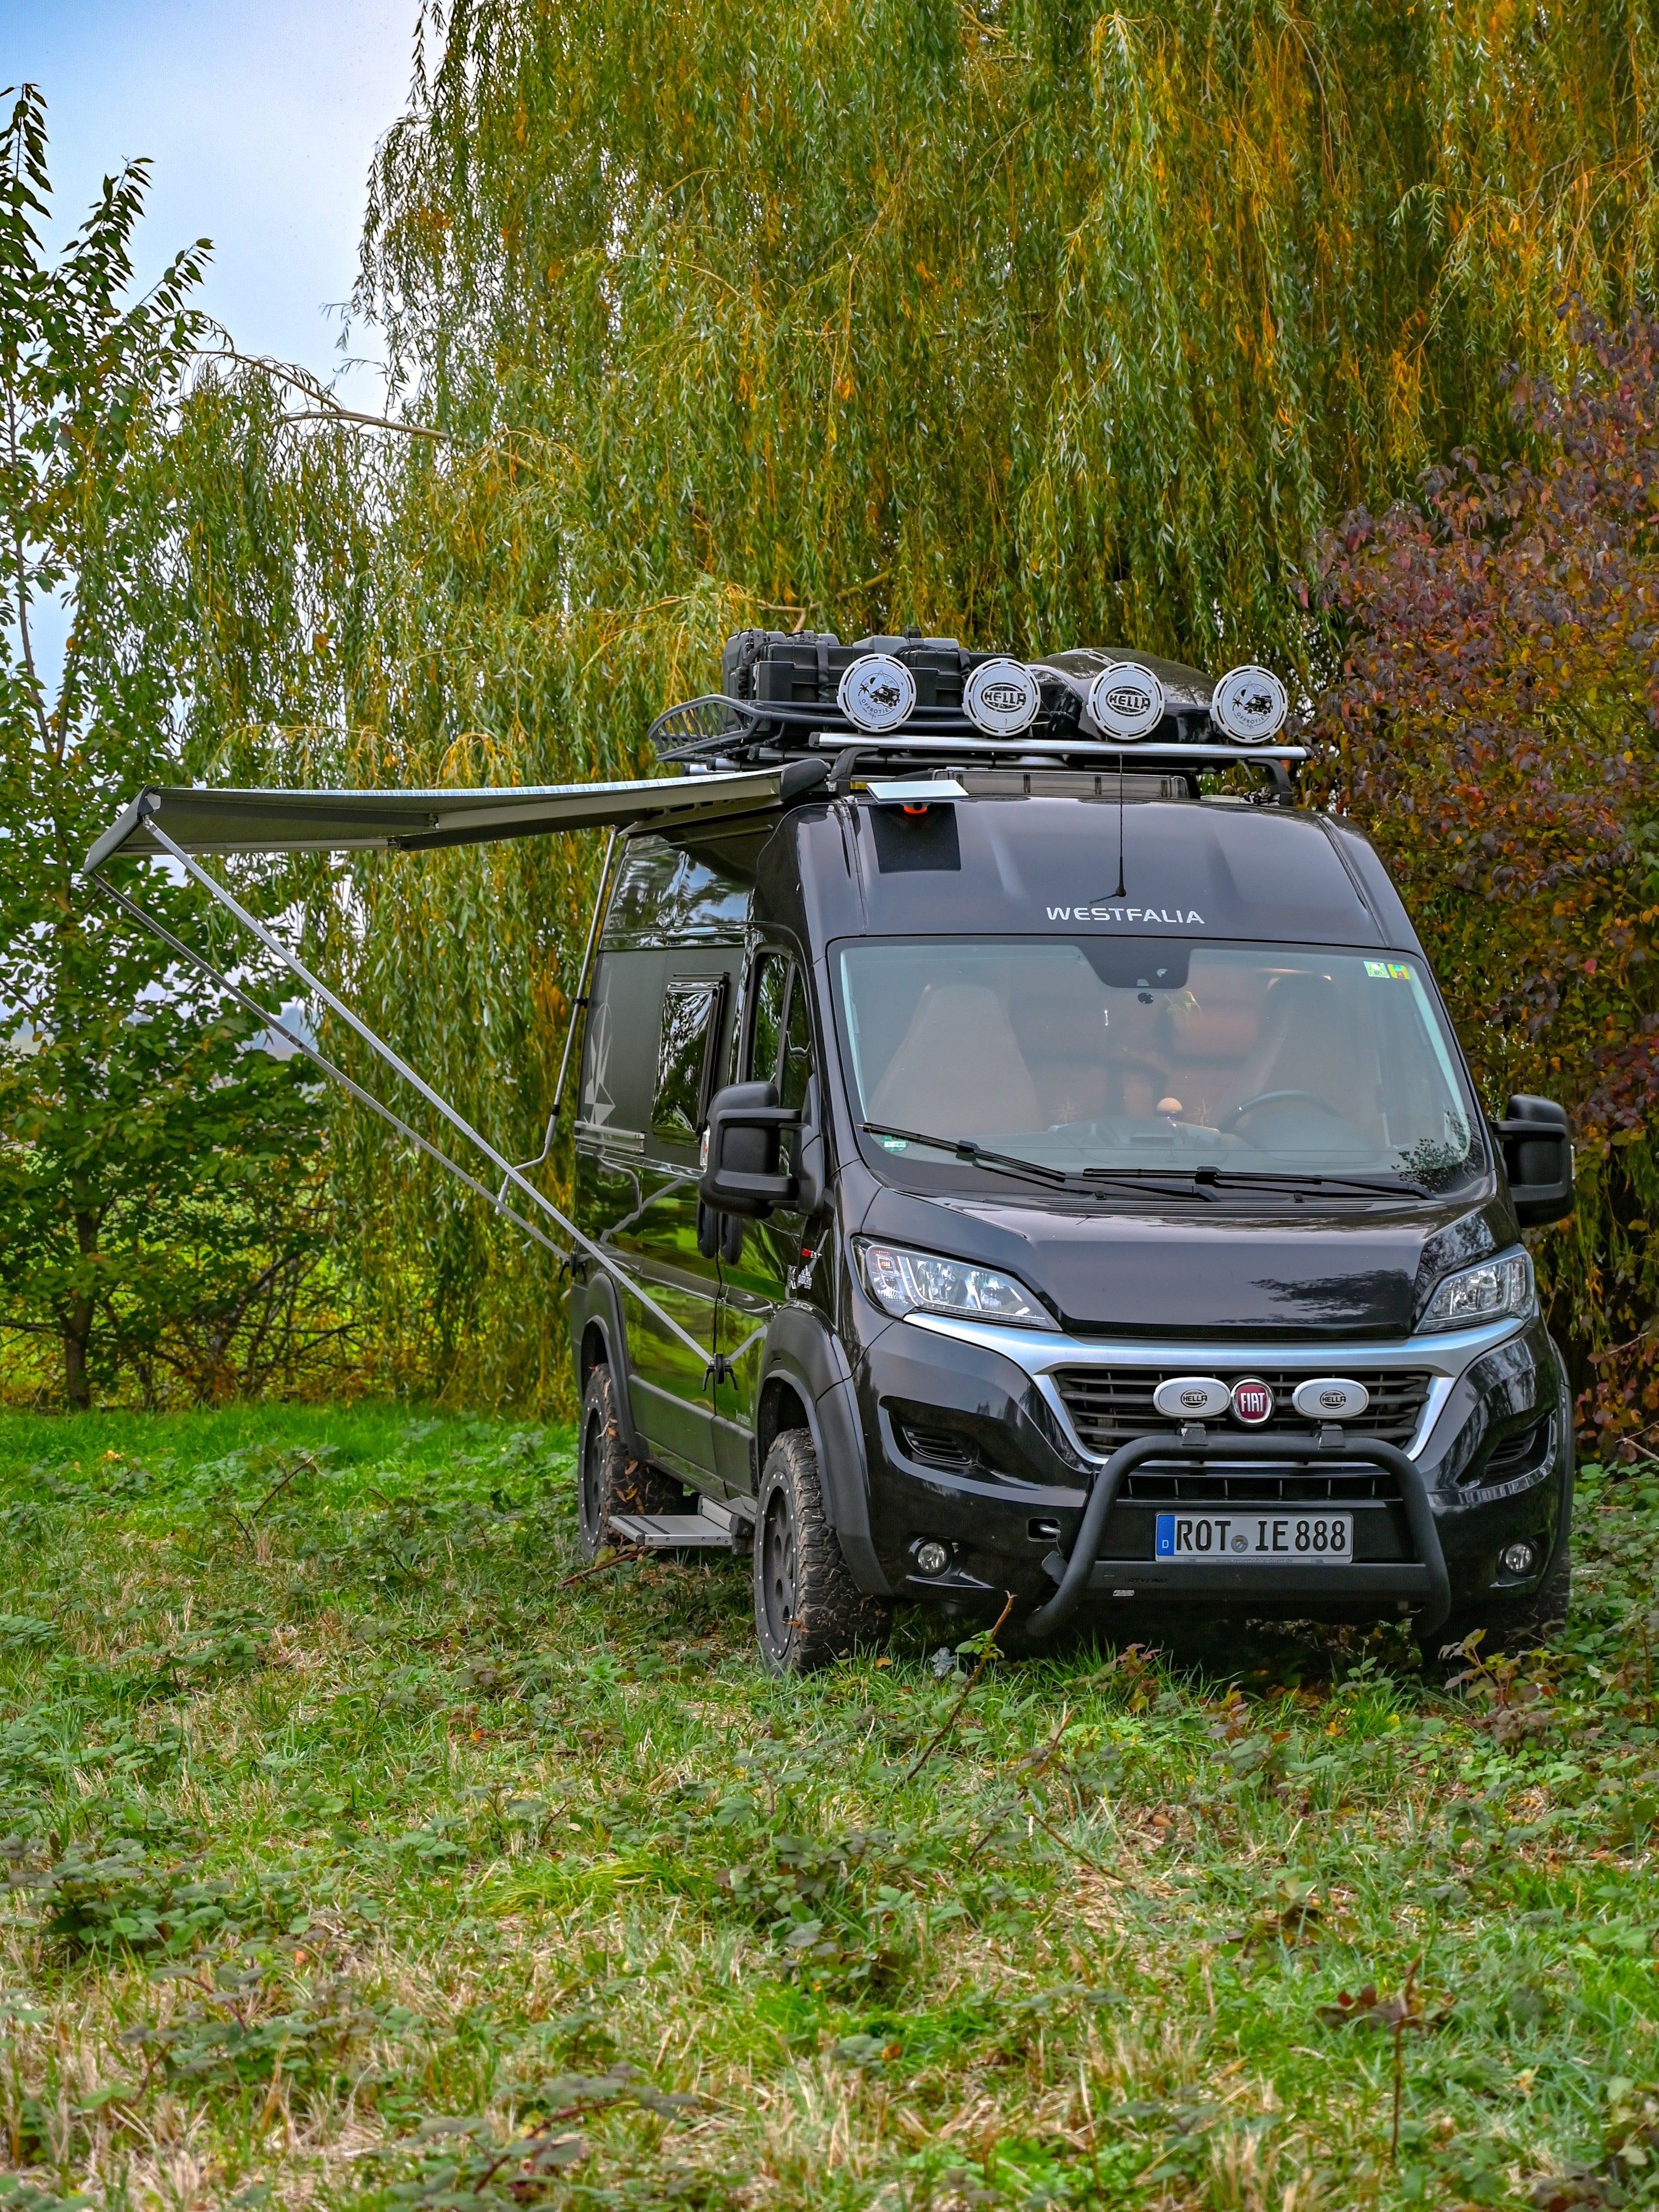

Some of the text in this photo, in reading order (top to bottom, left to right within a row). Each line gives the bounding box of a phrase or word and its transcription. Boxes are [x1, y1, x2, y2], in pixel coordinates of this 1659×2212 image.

[984, 691, 1026, 706] HELLA
[1109, 694, 1150, 711] HELLA
[1046, 907, 1206, 924] WESTFALIA
[1240, 1392, 1265, 1412] FIAT
[1176, 1519, 1231, 1551] ROT
[1162, 1540, 1169, 1548] D
